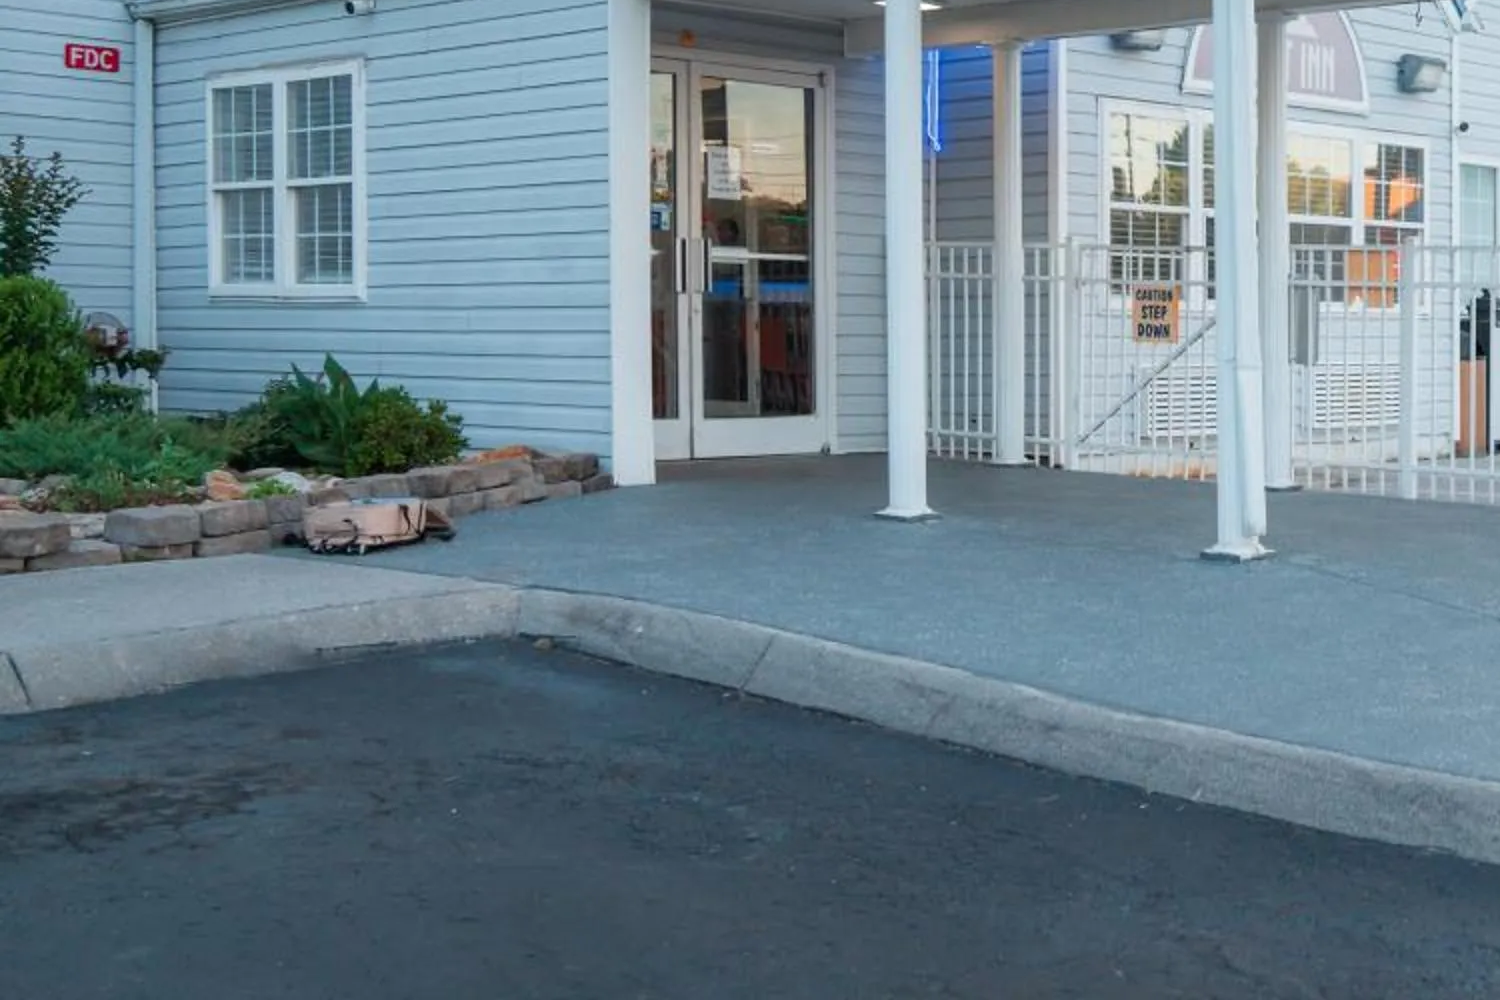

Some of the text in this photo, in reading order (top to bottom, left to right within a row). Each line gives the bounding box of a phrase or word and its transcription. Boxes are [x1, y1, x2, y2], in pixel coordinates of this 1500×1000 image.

[71, 46, 113, 70] FDC
[1301, 40, 1336, 93] INN
[1135, 288, 1173, 302] CAUTION
[1141, 304, 1168, 320] STEP
[1137, 322, 1170, 338] DOWN
